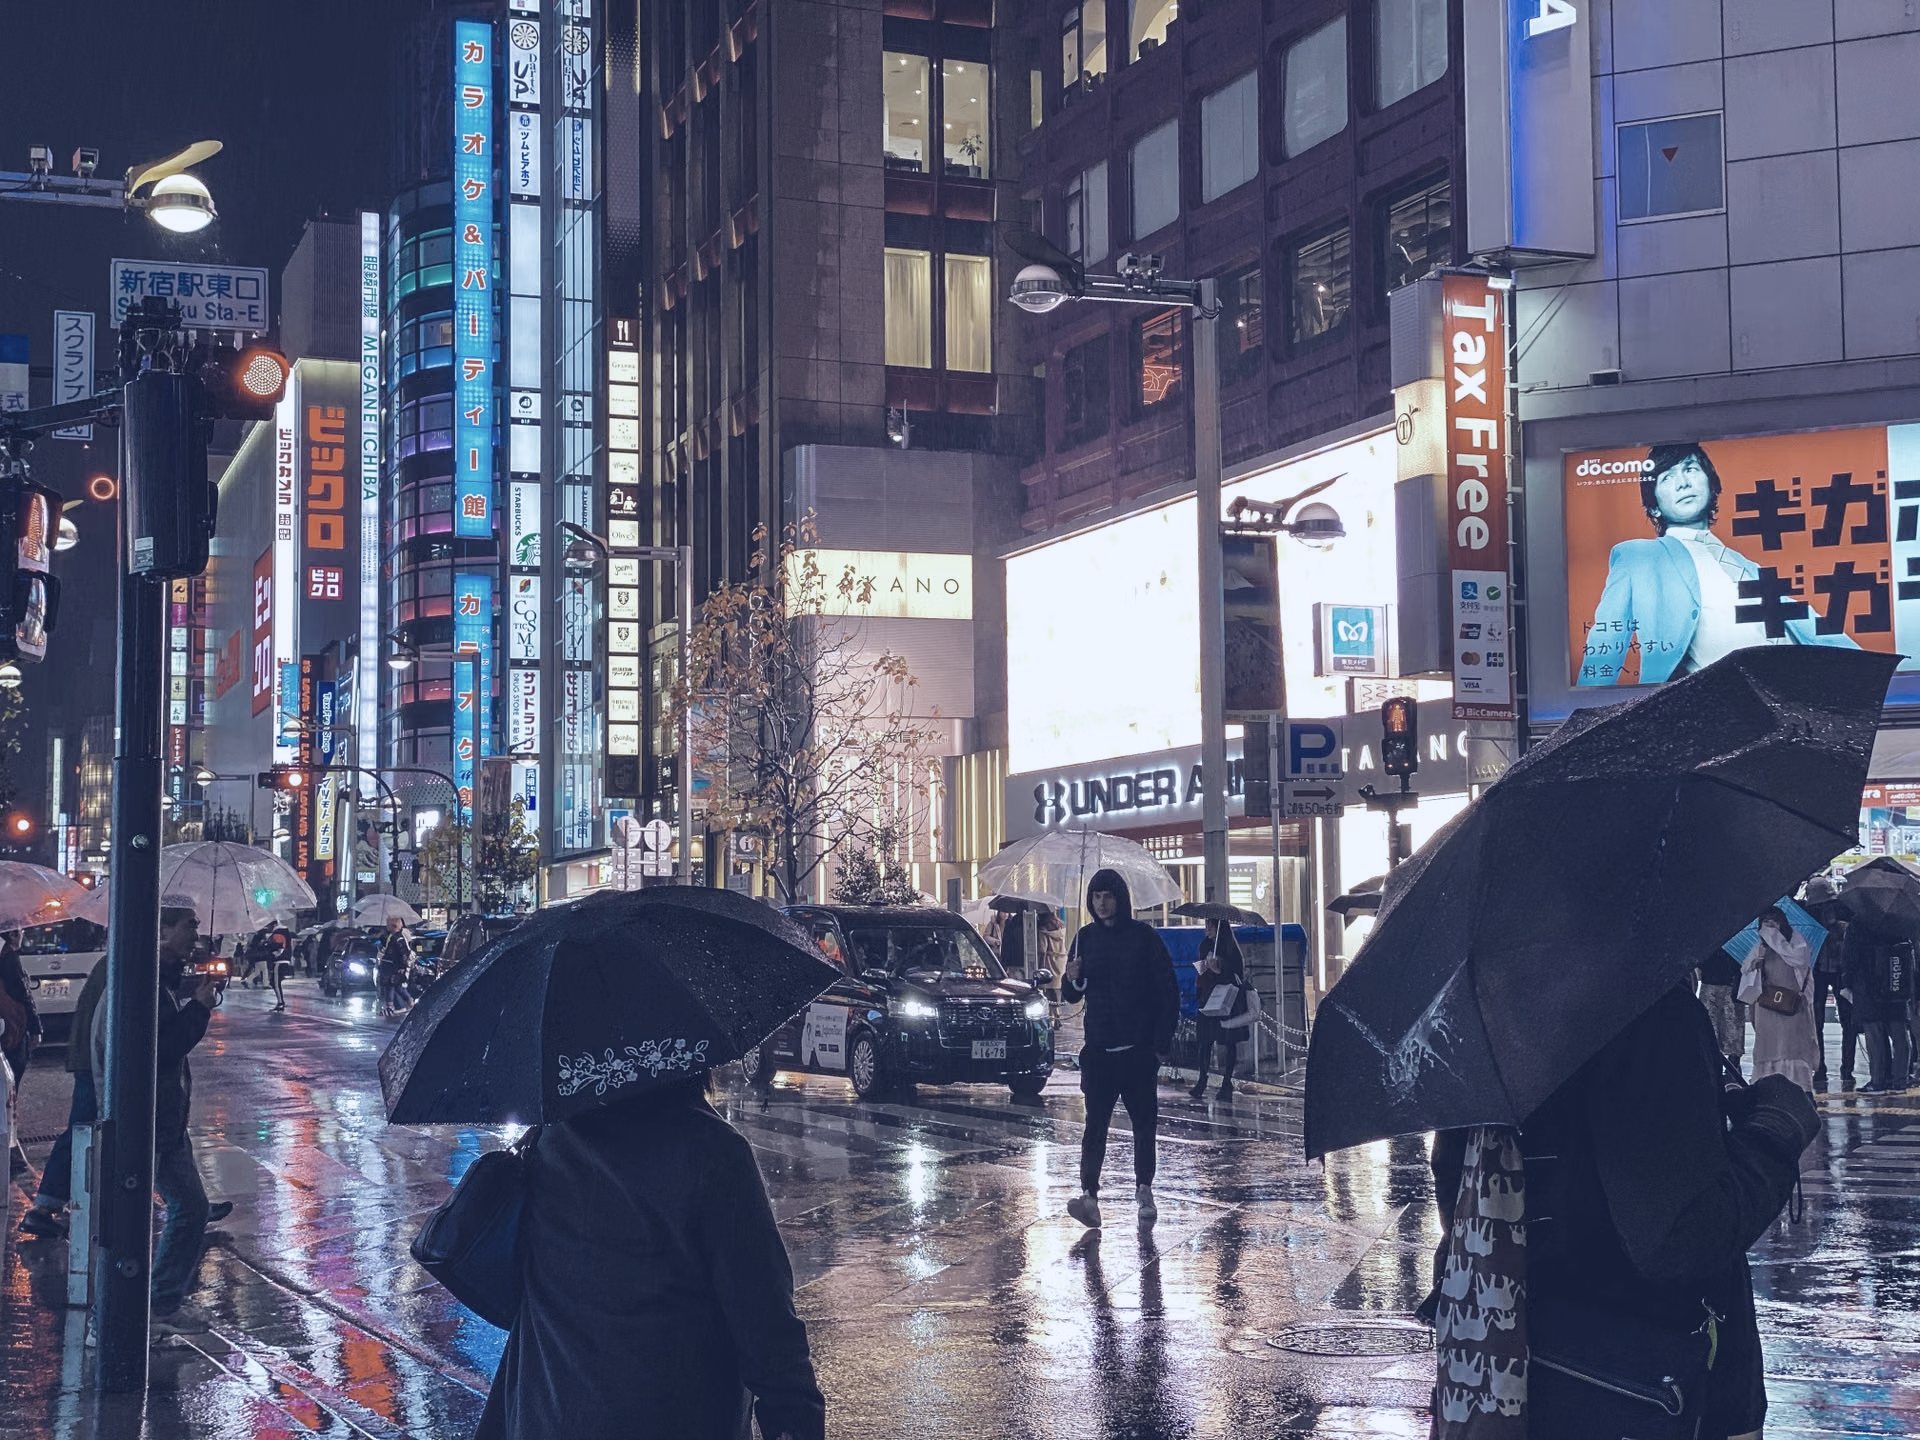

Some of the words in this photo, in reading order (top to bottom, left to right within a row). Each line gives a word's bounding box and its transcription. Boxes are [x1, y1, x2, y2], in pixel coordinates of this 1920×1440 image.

[119, 269, 260, 299] 新宿駅東口
[1452, 295, 1495, 405] Tax
[363, 335, 378, 423] MEGANE
[279, 428, 292, 505] ビックカメラ
[307, 405, 346, 549] ビックロ
[363, 431, 378, 500] ICHIBA
[1455, 418, 1498, 551] Free
[1576, 459, 1656, 476] docomo
[514, 487, 522, 537] STARBUCKS
[1732, 469, 1920, 551] ギガ
[817, 573, 960, 595] TKANO
[1735, 558, 1920, 639] ギガ
[1583, 619, 1641, 634] ドコモは
[1583, 640, 1675, 654] わかりやすい
[1583, 664, 1641, 679] 料金へ。
[523, 671, 536, 750] サンドラッグ
[1466, 708, 1512, 718] BicCamera
[1290, 724, 1336, 774] P
[1070, 769, 1177, 815] UNDER
[980, 1047, 1005, 1058] 16-78
